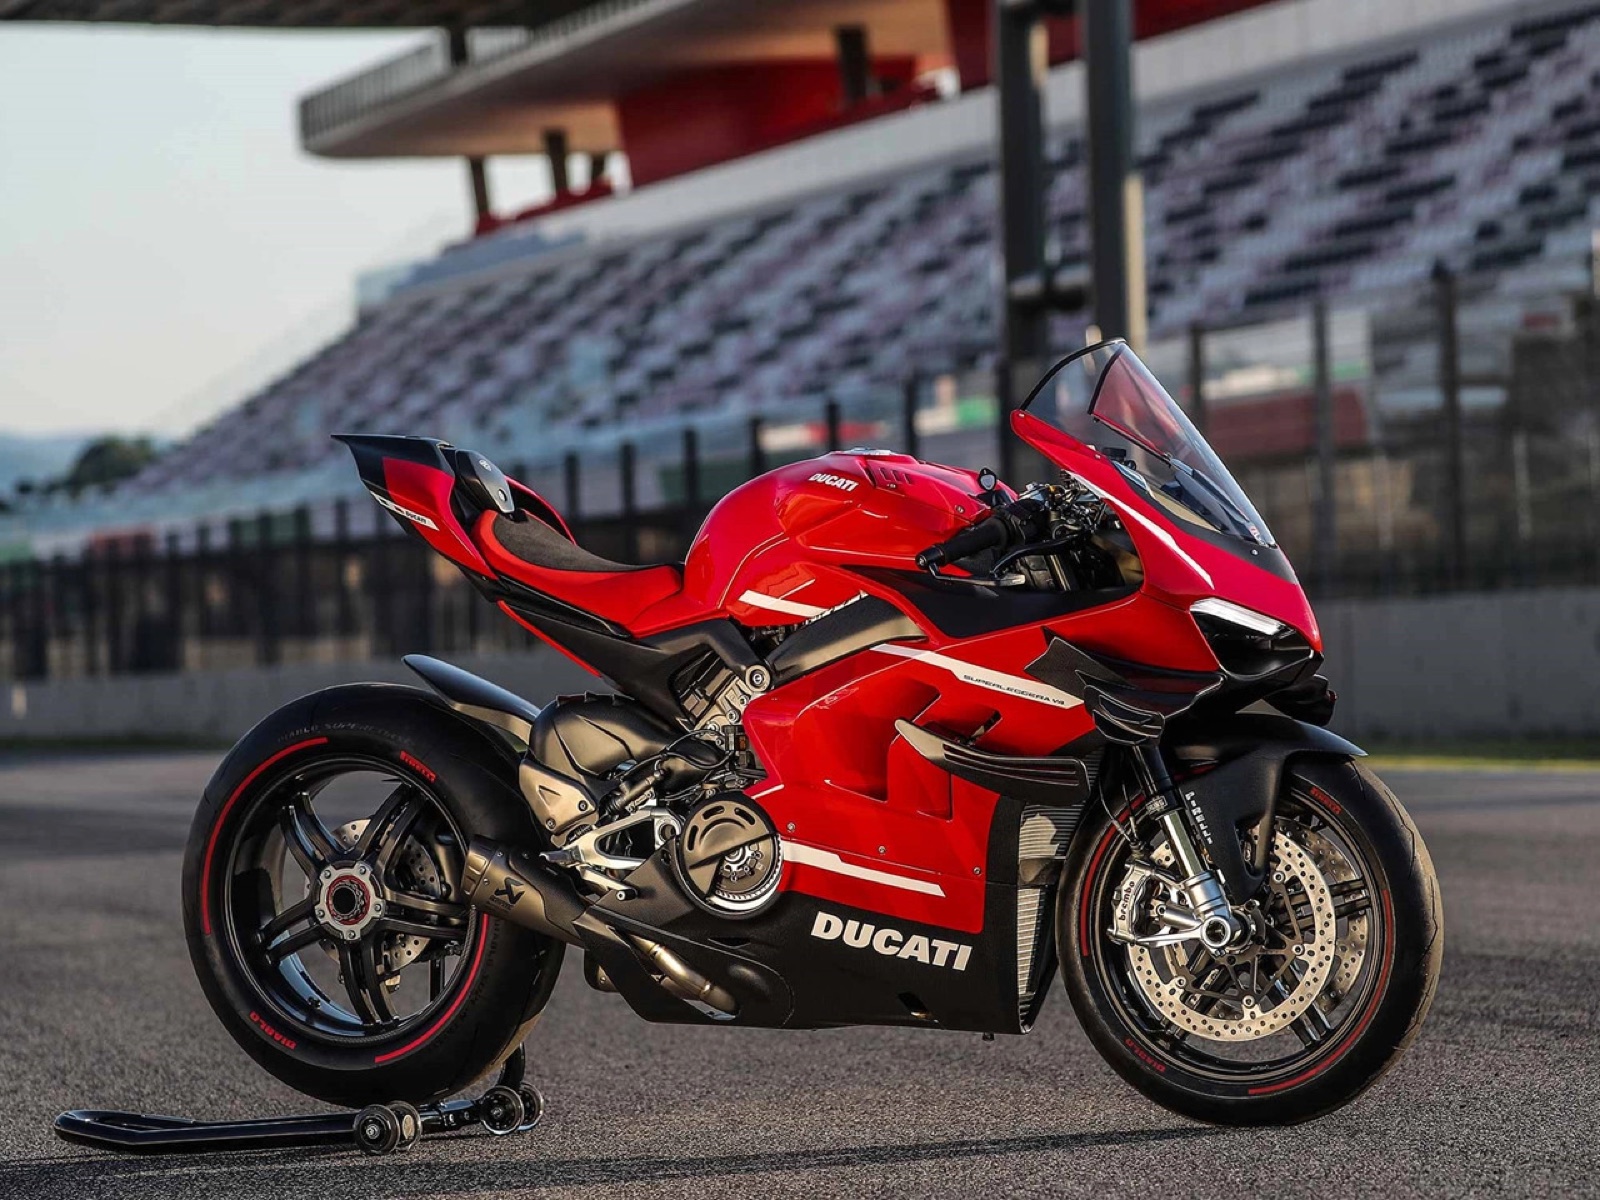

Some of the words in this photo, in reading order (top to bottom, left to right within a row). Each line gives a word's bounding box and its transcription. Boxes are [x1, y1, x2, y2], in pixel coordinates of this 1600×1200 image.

[807, 473, 859, 492] DUCATI
[404, 510, 427, 525] DUCATI
[1118, 881, 1135, 921] brembo
[811, 911, 973, 971] DUCATI
[250, 1010, 297, 1050] DIABLO
